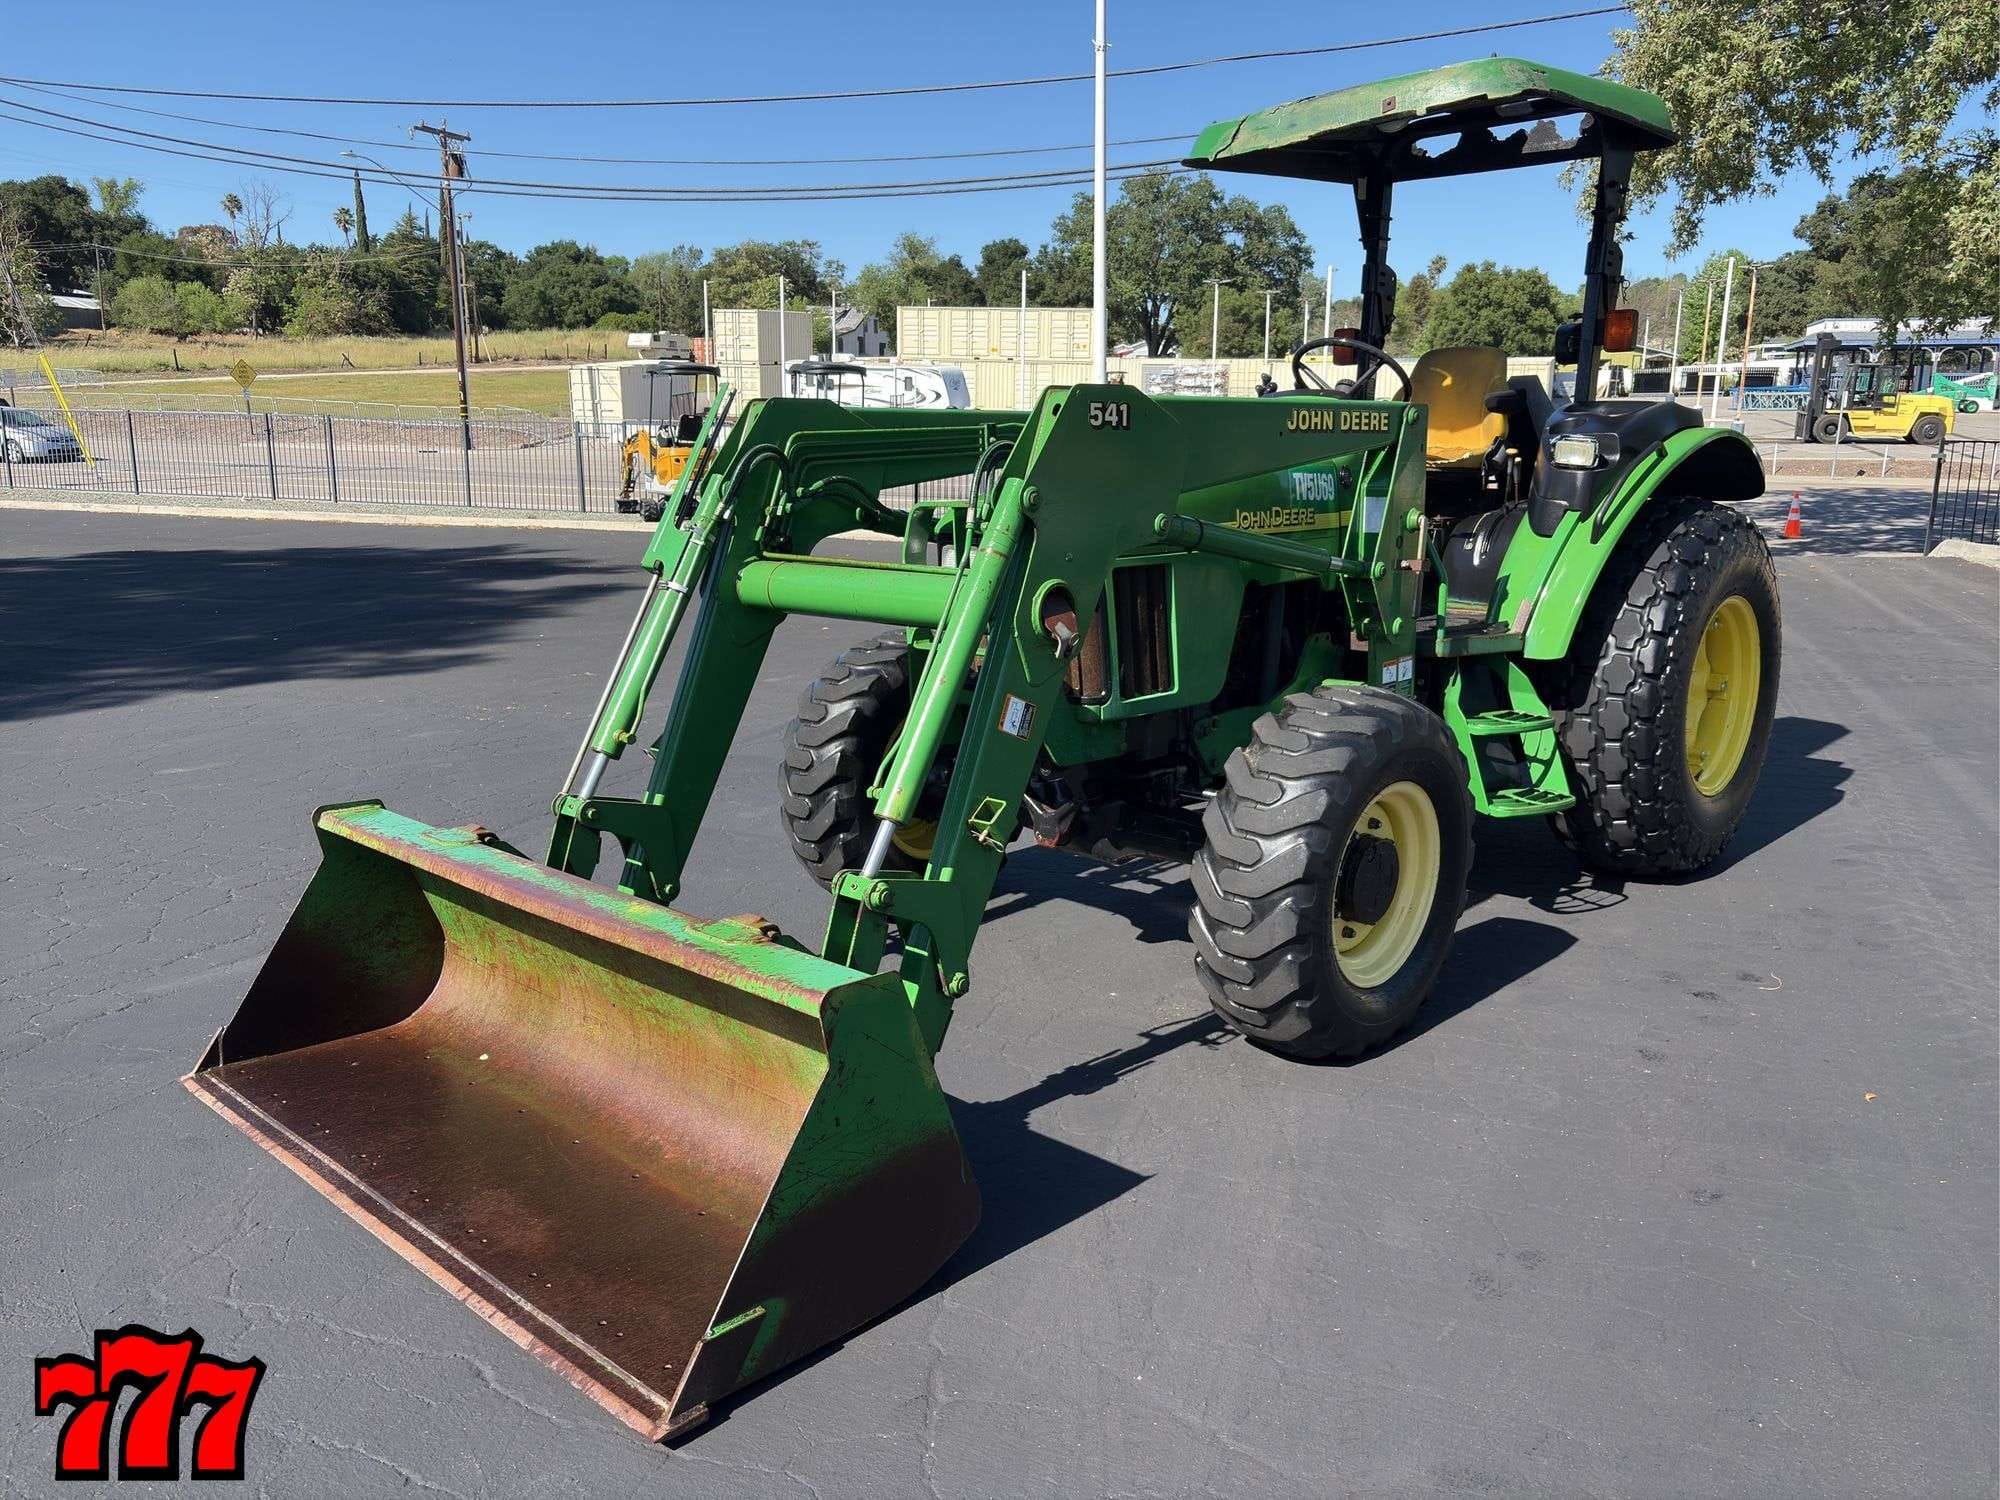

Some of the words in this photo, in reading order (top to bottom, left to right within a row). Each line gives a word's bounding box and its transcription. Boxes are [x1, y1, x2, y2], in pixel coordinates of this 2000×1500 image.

[1089, 402, 1129, 428] 541
[1287, 410, 1334, 431] JOHN
[1340, 411, 1389, 431] DEERE
[1233, 508, 1270, 530] JOHN
[1271, 506, 1314, 527] DEERE
